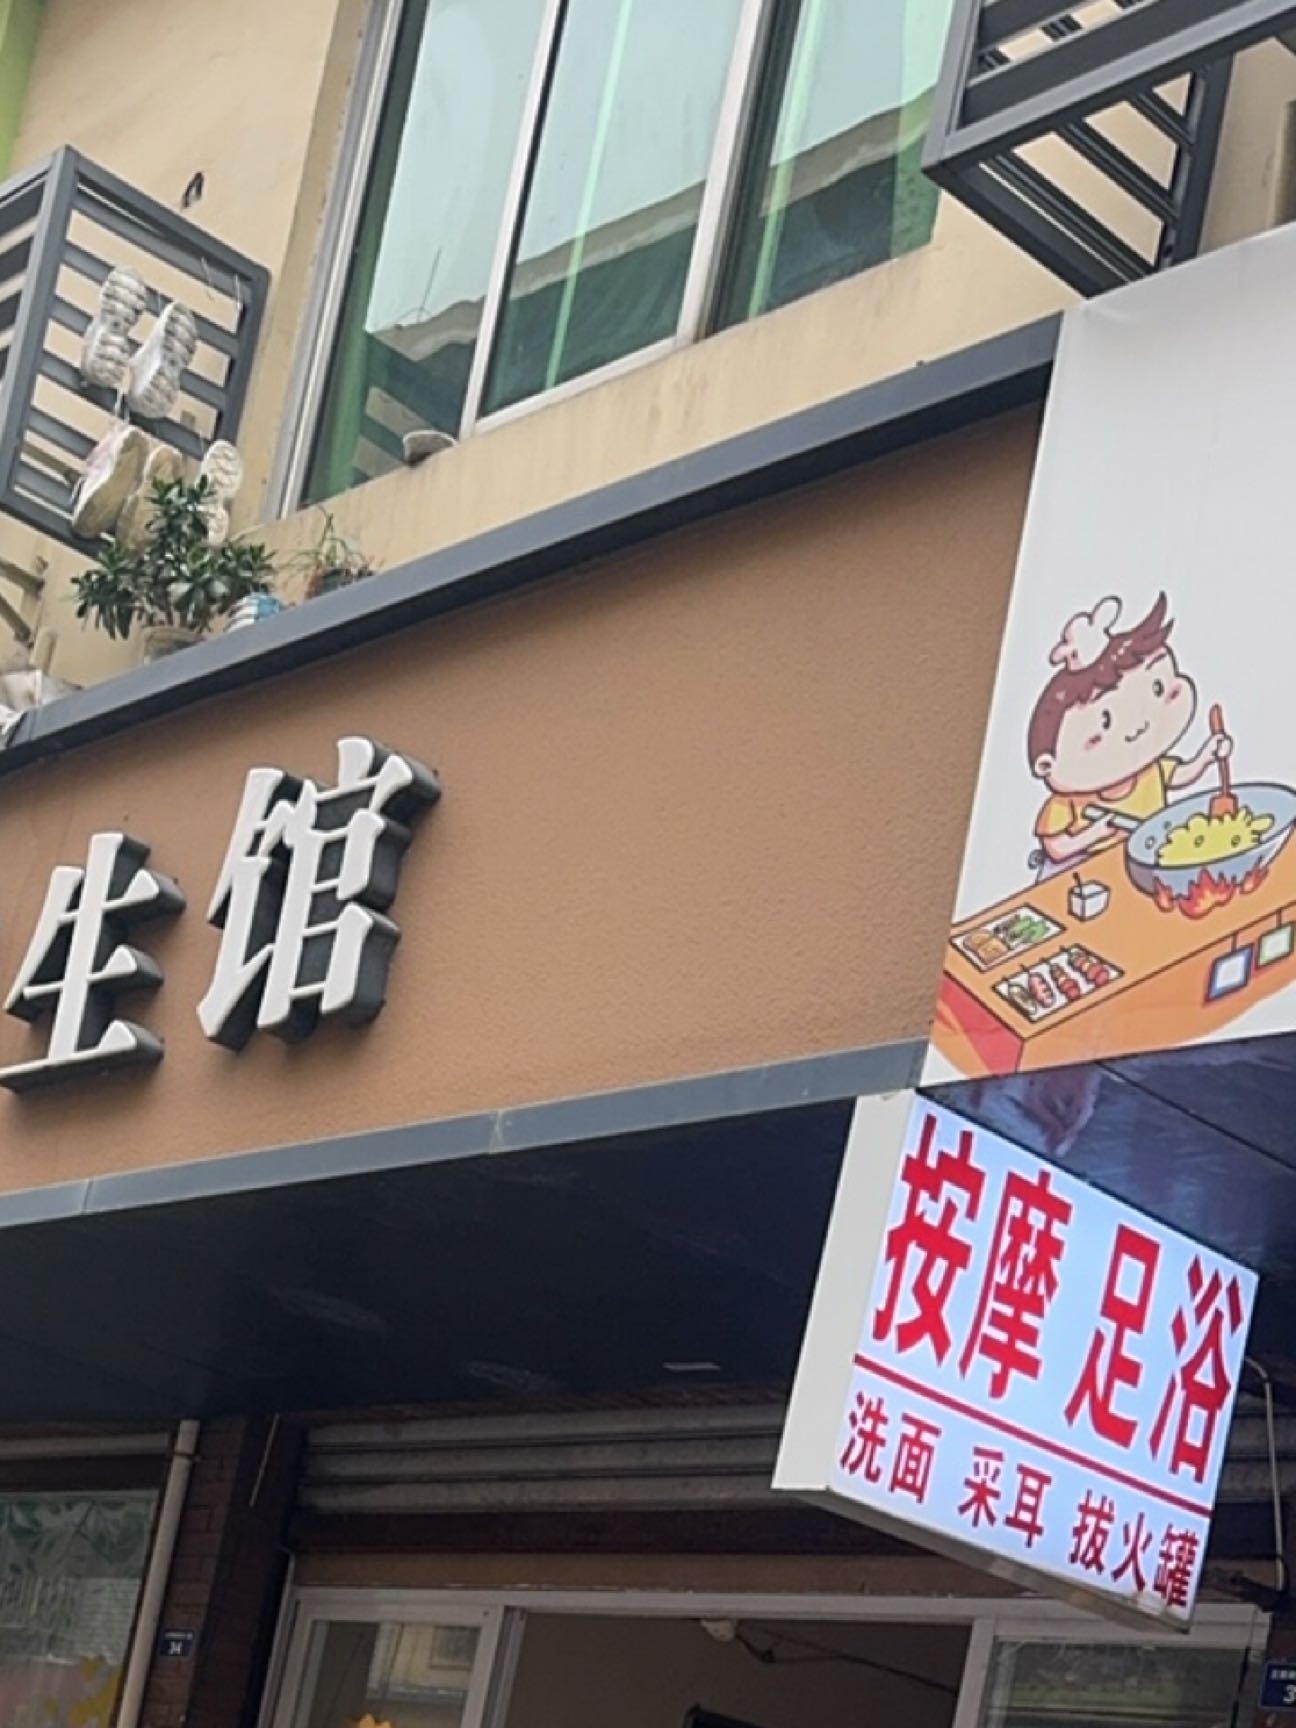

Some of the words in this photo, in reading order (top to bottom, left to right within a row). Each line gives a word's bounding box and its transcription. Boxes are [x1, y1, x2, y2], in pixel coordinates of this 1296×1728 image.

[870, 1112, 1074, 1400] 按摩
[1063, 1222, 1244, 1485] 足浴
[839, 1391, 943, 1504] 洗面
[957, 1446, 1053, 1549] 采耳
[1067, 1490, 1199, 1609] 拔火罐
